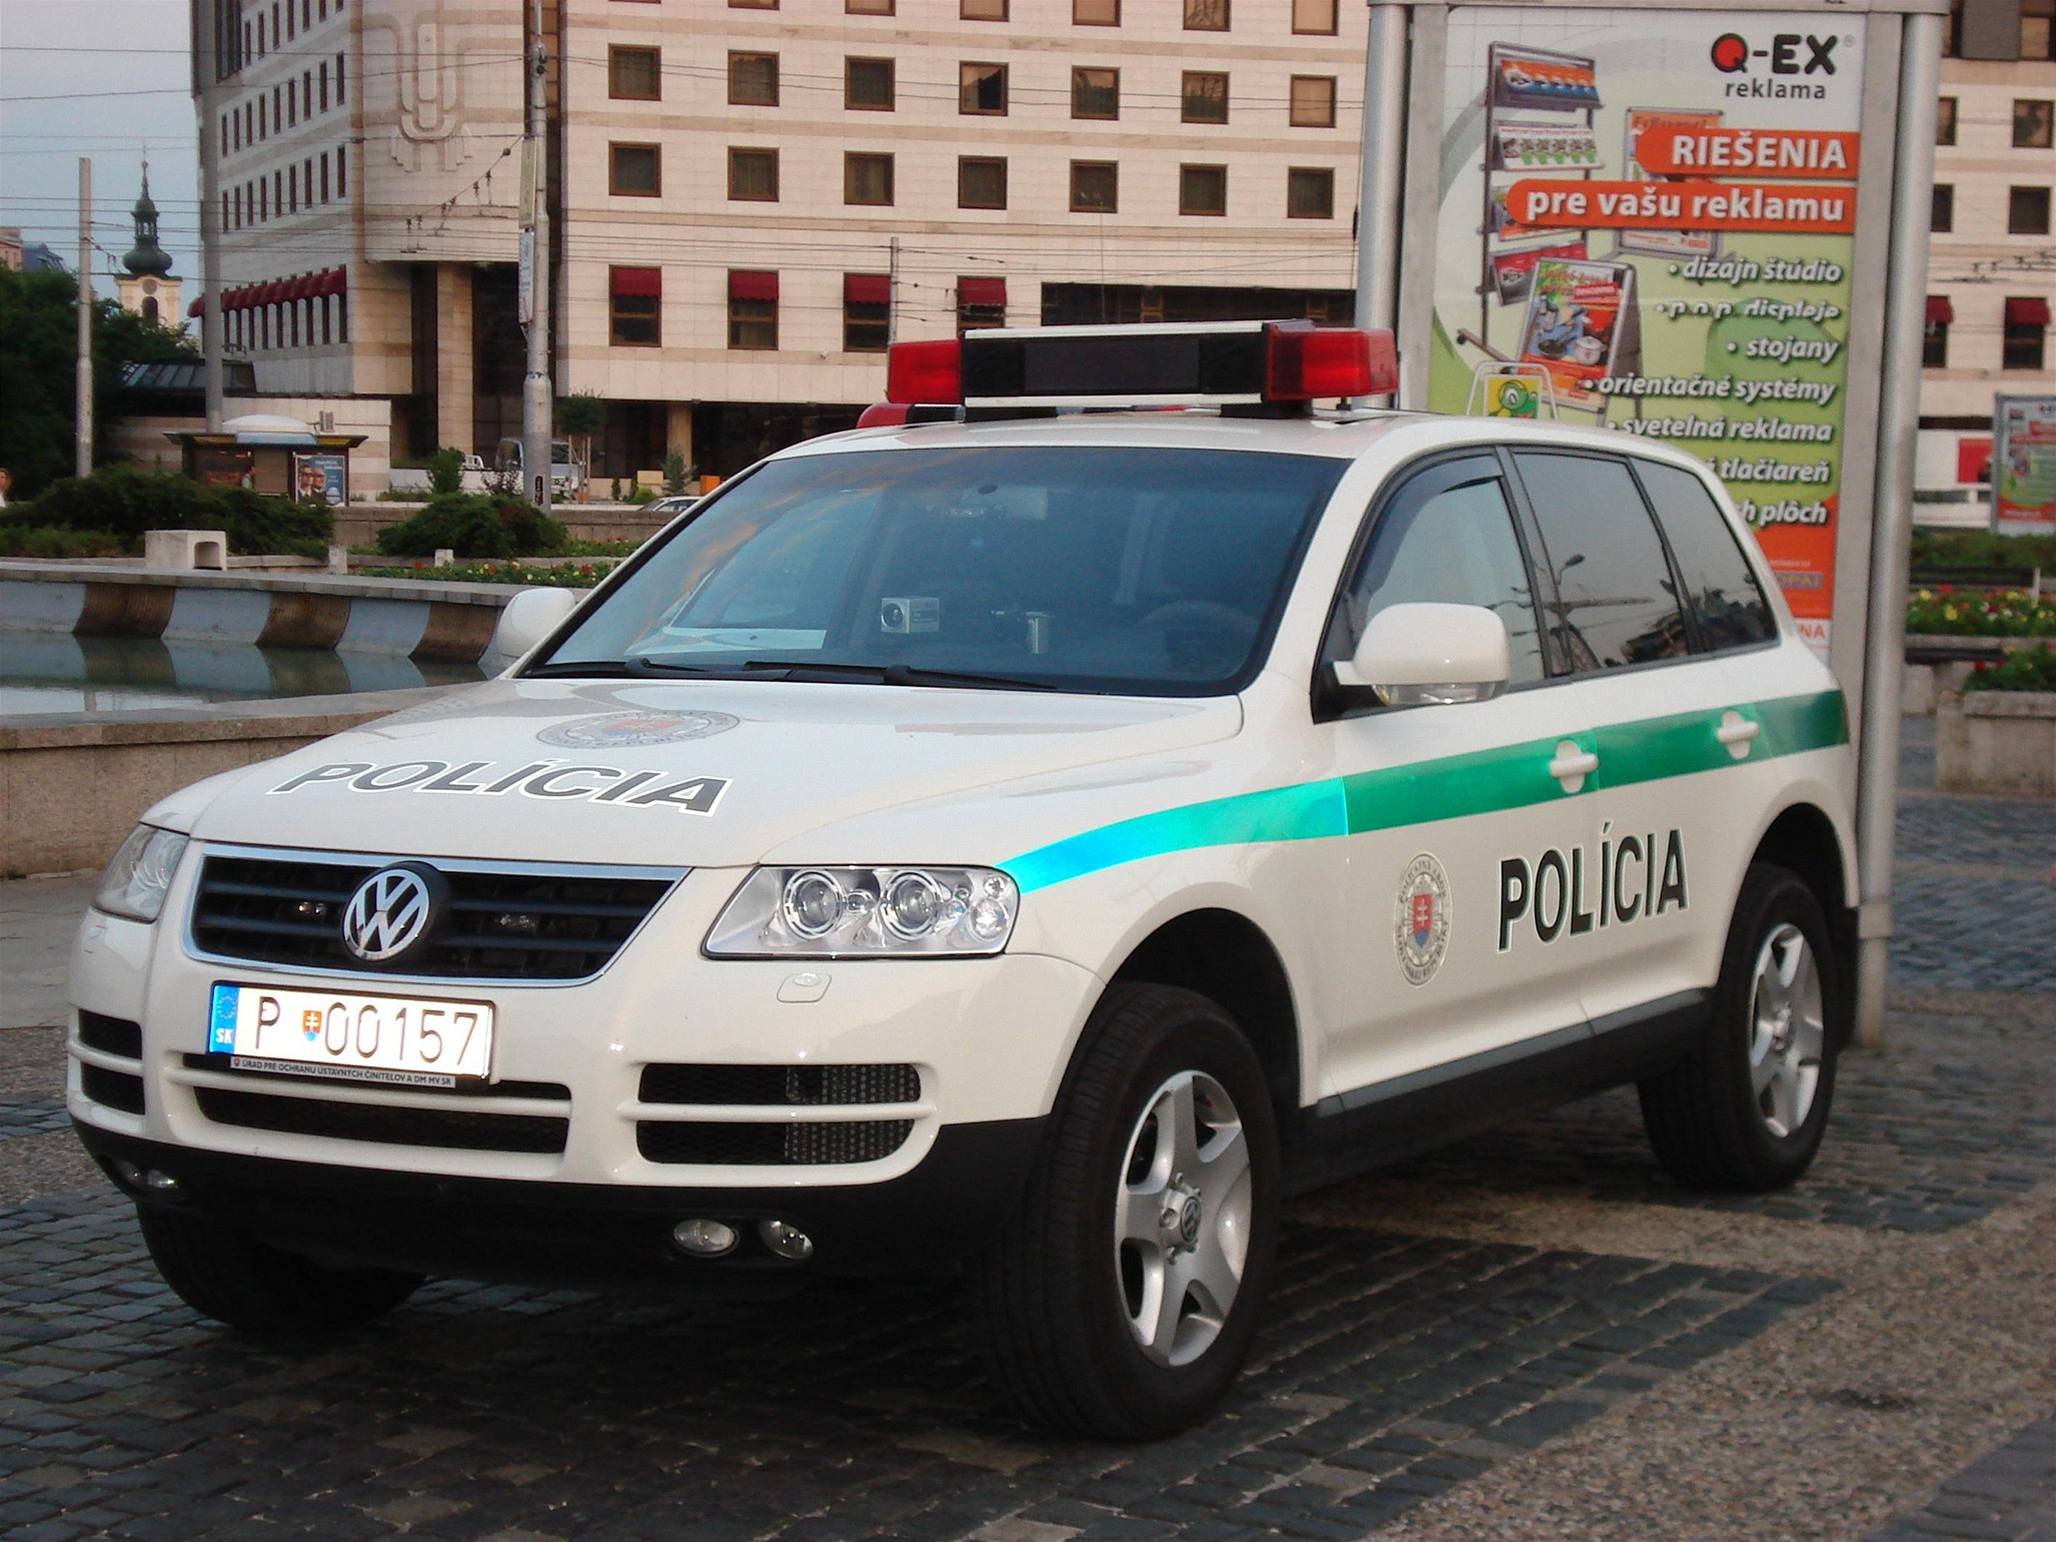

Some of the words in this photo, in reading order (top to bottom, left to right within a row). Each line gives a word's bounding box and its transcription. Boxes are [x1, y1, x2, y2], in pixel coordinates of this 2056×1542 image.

[1725, 78, 1826, 99] reklama
[1671, 131, 1847, 169] RIEŠENIA
[1526, 190, 1587, 221] pre
[1597, 186, 1681, 217] vašu
[1691, 188, 1844, 221] reklamu
[1682, 255, 1760, 285] dizajn
[1763, 256, 1843, 283] štúdio
[1746, 336, 1840, 364] stojany
[1599, 373, 1730, 397] orientačné
[1734, 376, 1837, 405] systémy
[1622, 415, 1725, 438] svetelná
[1727, 417, 1833, 441] reklama
[1720, 457, 1831, 482] tlačiareň
[1760, 500, 1828, 525] plôch
[267, 758, 733, 815] POLÍCIA
[1498, 819, 1688, 952] POLÍCIA
[216, 1028, 233, 1043] SK
[255, 996, 281, 1050] P
[325, 1002, 478, 1065] 00157
